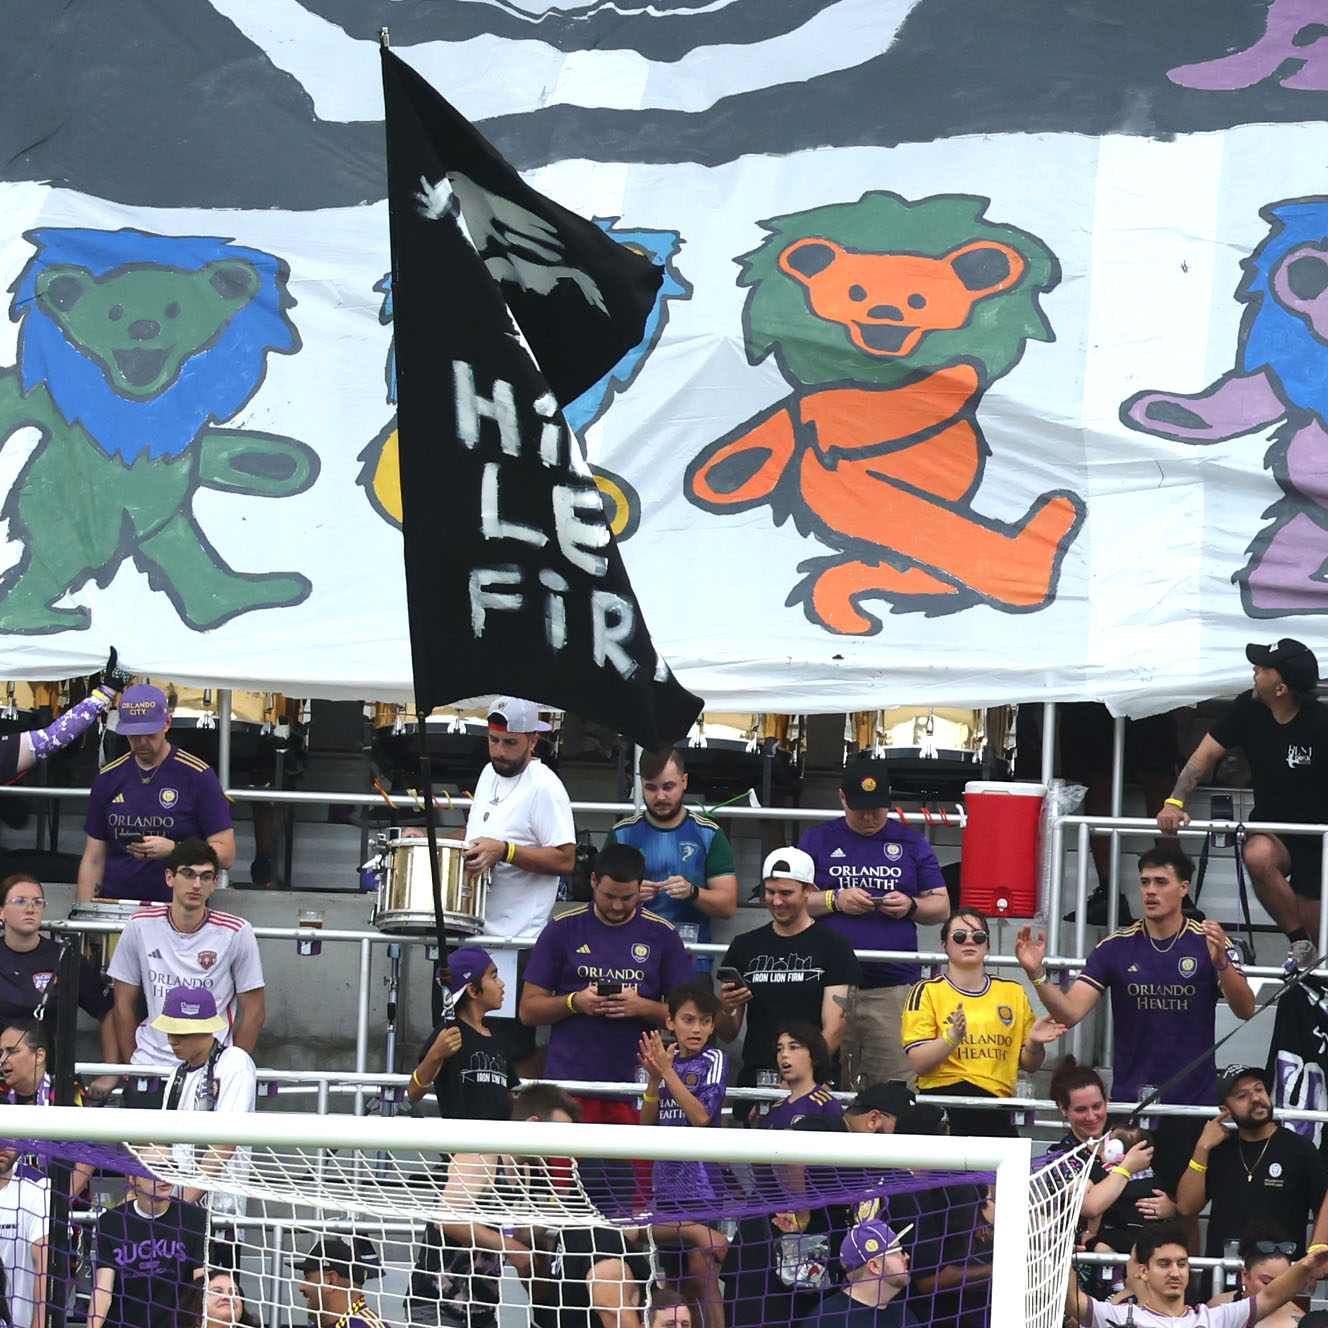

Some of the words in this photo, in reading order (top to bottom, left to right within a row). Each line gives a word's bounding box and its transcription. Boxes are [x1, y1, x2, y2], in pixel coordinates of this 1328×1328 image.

[121, 700, 156, 710] ORLANDO
[129, 708, 147, 716] CITY
[108, 813, 174, 828] ORLANDO
[829, 865, 902, 878] ORLANDO
[839, 877, 896, 891] HEALTH
[148, 969, 214, 989] ORLANDO
[576, 964, 645, 981] ORLANDO
[752, 973, 770, 983] IRON
[770, 972, 787, 983] LION
[787, 971, 805, 982] FIRM
[1127, 982, 1196, 997] ORLANDO
[1137, 996, 1190, 1011] HEALTH
[960, 1033, 1013, 1047] RLANDO
[957, 1046, 1008, 1062] HEALTH
